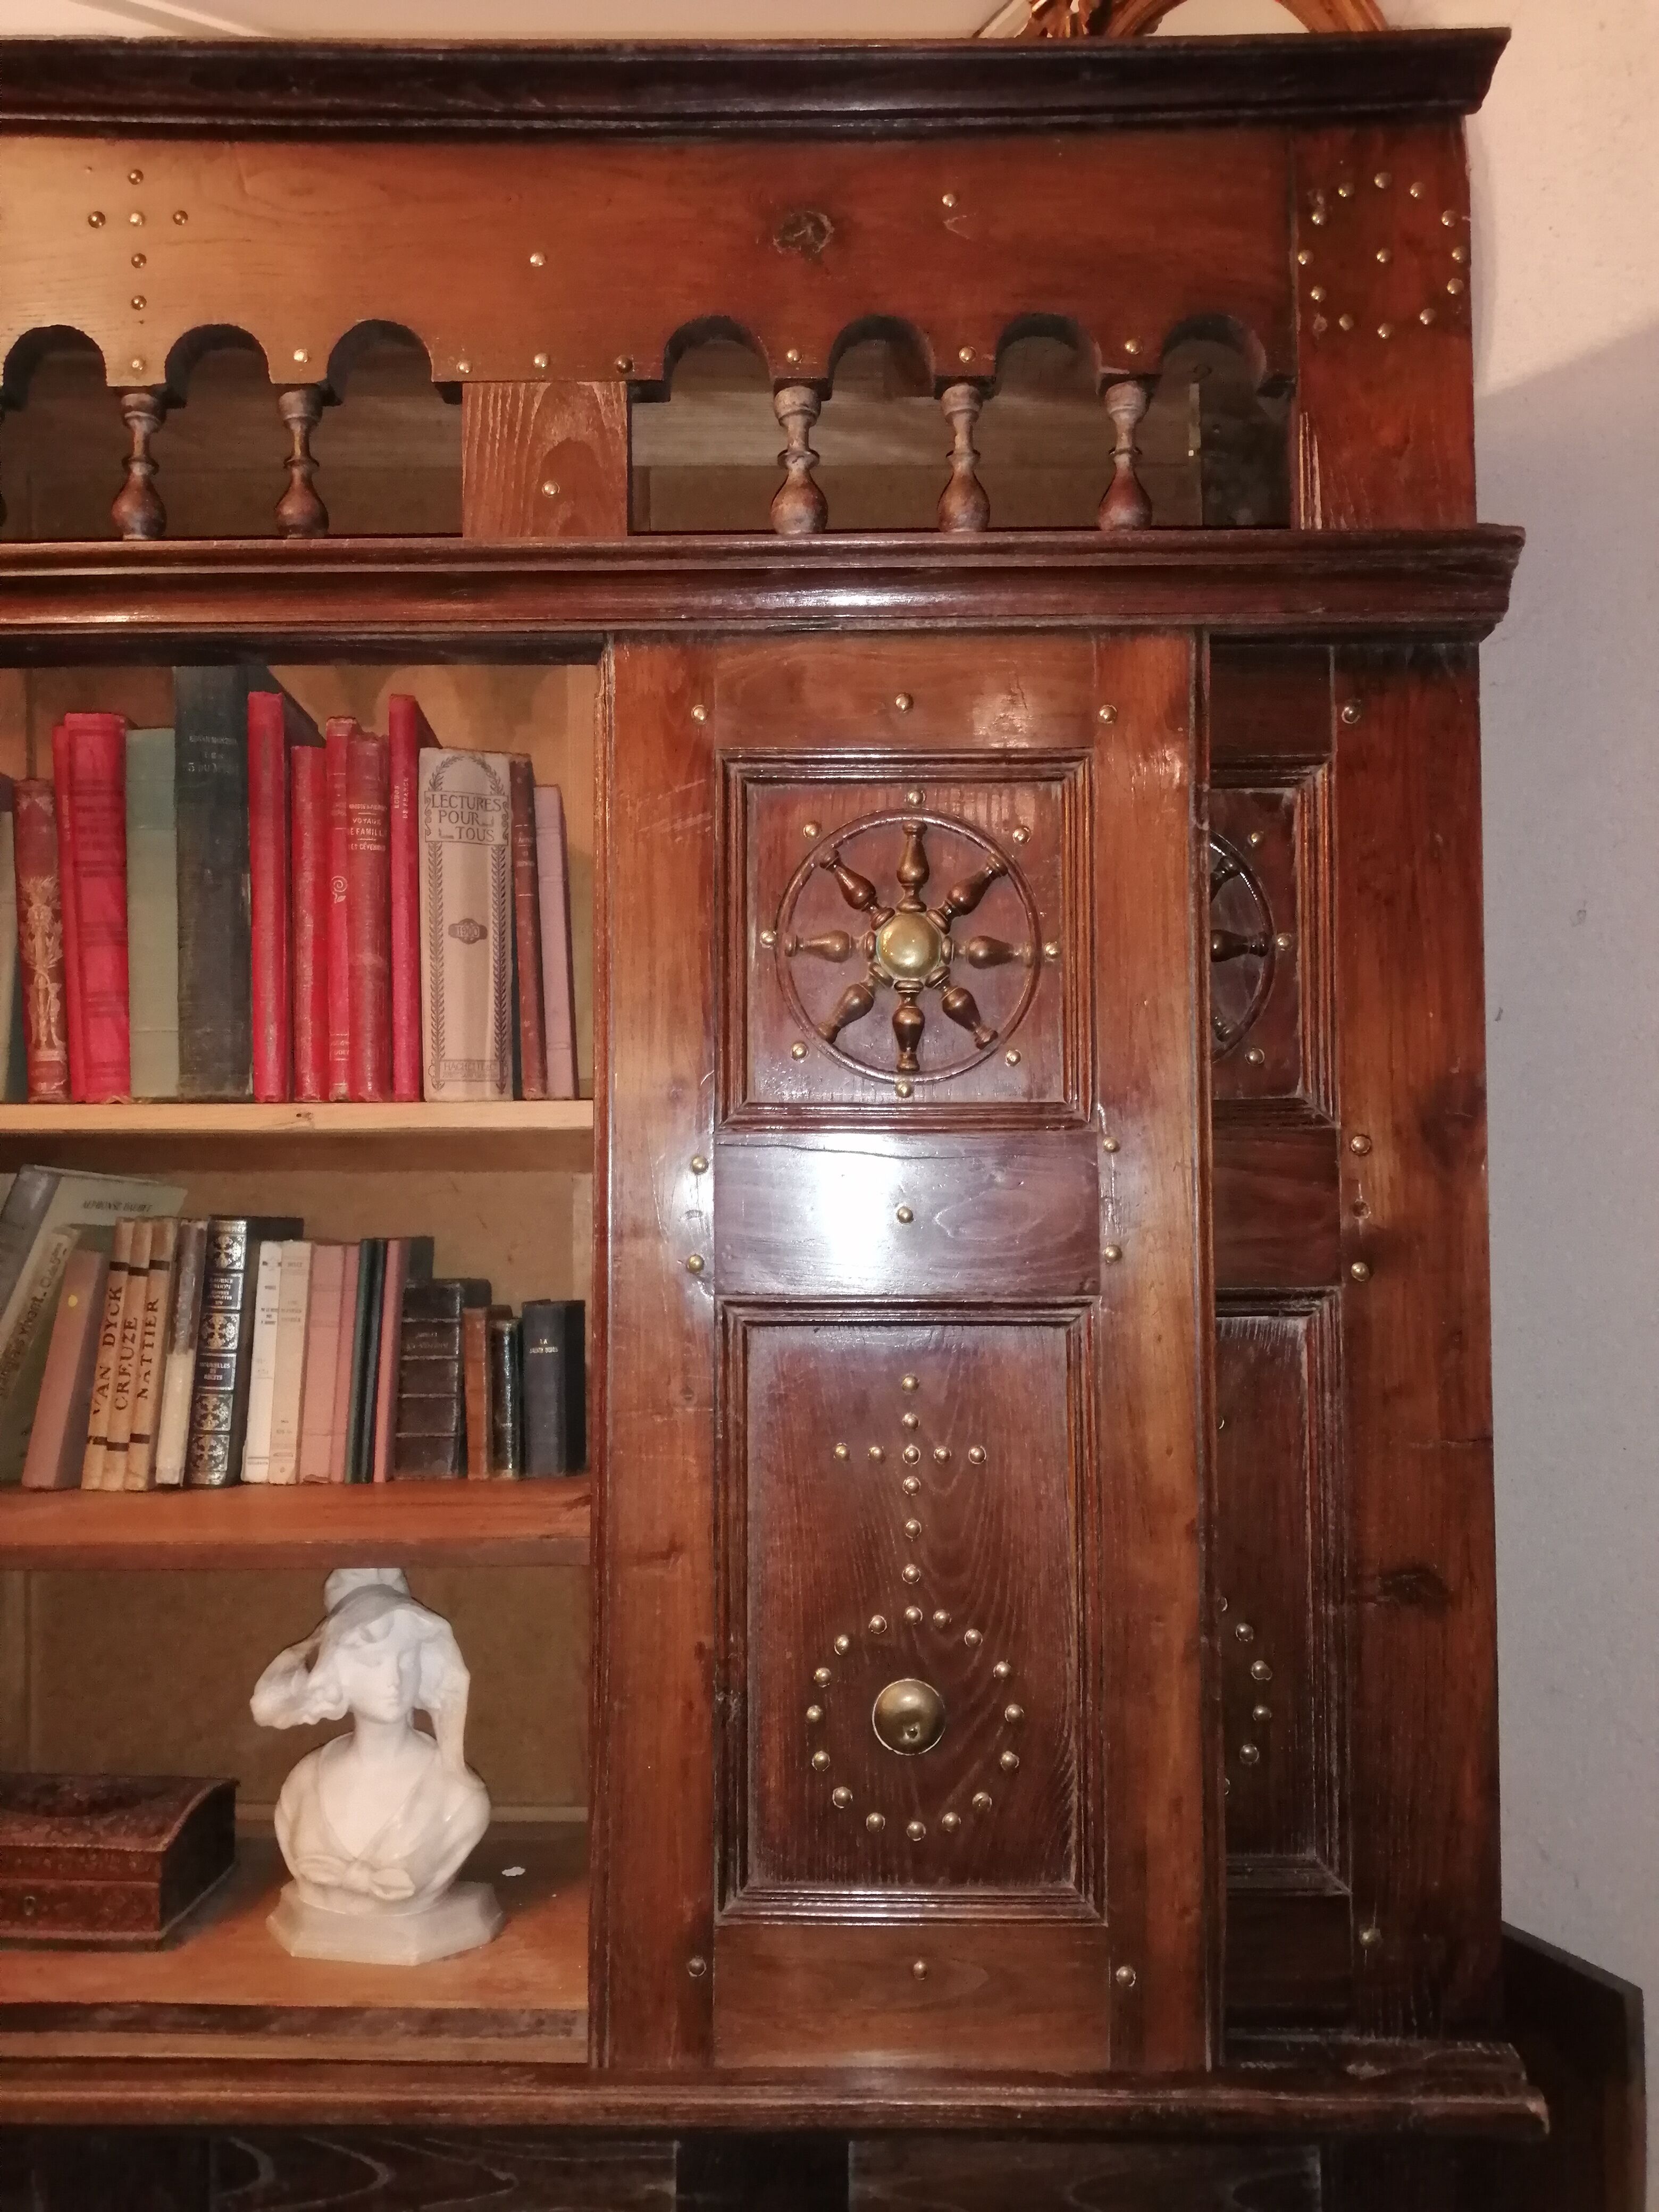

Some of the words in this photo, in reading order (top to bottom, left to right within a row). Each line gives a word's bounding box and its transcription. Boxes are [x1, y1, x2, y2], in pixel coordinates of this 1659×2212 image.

[432, 794, 501, 812] LECTURES
[439, 810, 480, 826] POUR
[455, 826, 495, 842] TOUS
[93, 1365, 111, 1415] VAN
[102, 1287, 123, 1347] DYCK
